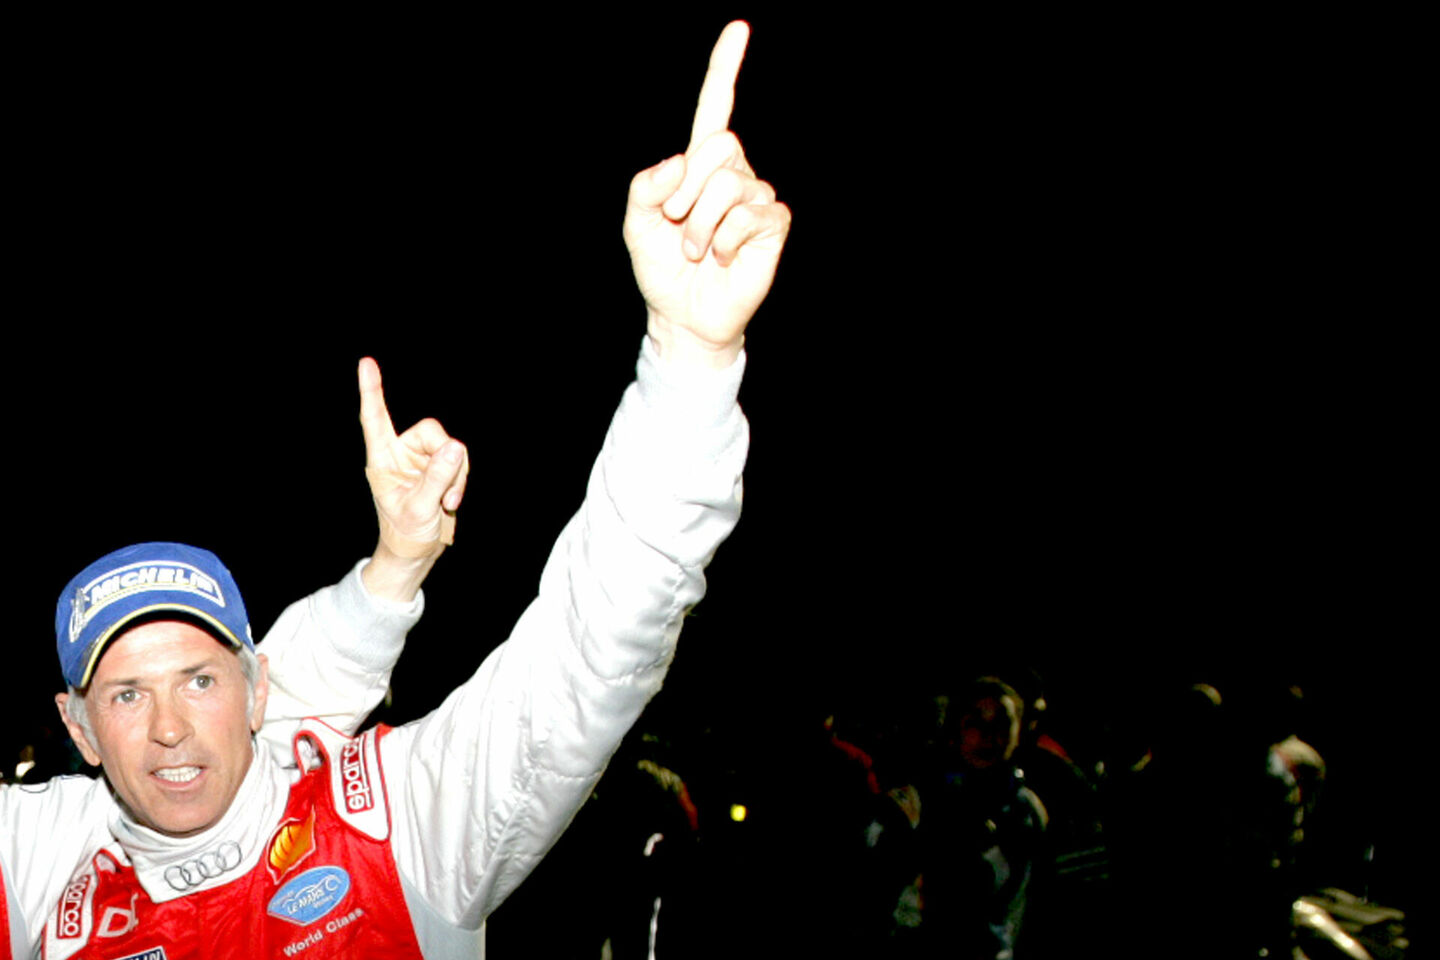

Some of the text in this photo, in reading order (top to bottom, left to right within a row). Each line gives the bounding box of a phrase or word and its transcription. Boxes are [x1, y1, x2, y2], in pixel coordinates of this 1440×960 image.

[90, 567, 214, 601] MICHELIN
[283, 907, 364, 957] World Class
